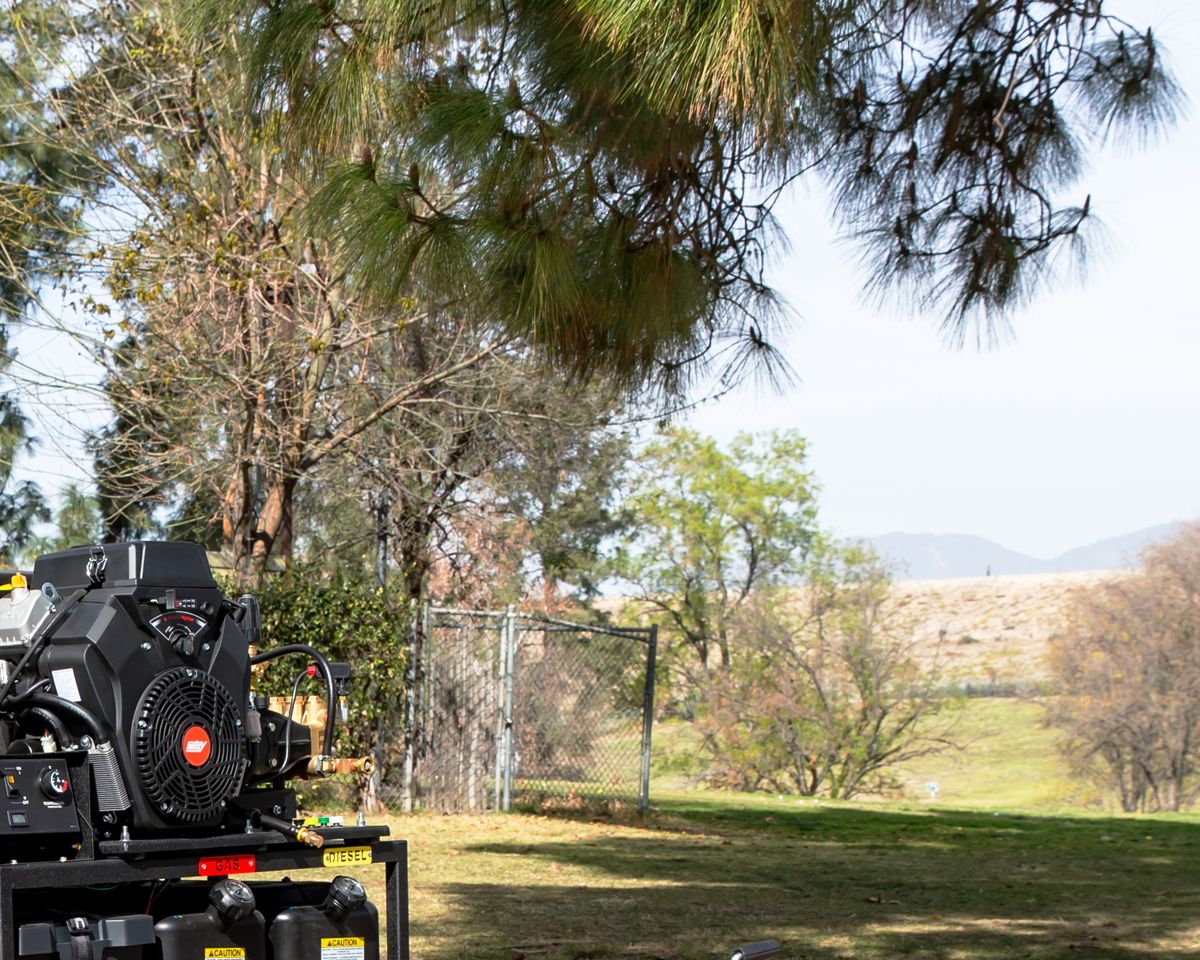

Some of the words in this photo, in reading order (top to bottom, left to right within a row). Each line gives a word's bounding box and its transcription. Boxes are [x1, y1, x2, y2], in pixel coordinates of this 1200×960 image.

[329, 850, 367, 862] DIESEL
[216, 858, 240, 871] GAS
[332, 939, 358, 947] CAUTION
[214, 949, 241, 957] CAUTION
